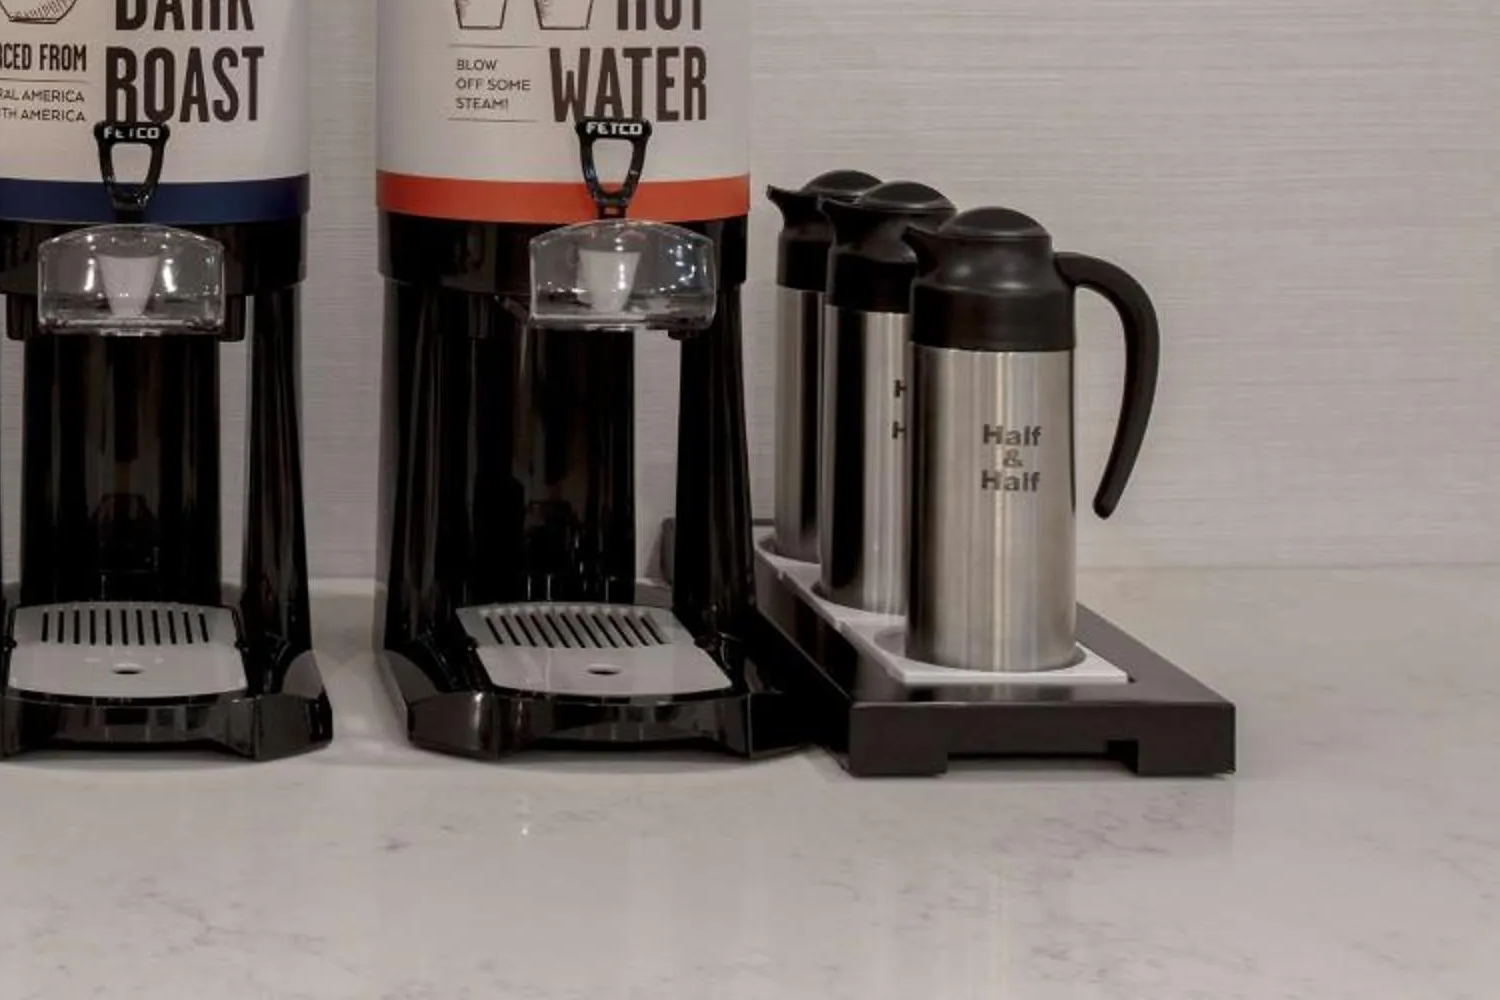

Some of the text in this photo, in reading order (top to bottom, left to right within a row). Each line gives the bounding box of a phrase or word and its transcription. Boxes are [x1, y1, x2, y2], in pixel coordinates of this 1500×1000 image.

[39, 43, 87, 72] FROM
[456, 58, 498, 72] BLOW
[106, 45, 265, 123] ROAST
[455, 78, 532, 92] OFF SOME
[549, 46, 708, 123] WATER
[22, 88, 85, 103] AMERICA
[20, 108, 86, 122] AMERICA
[585, 122, 643, 135] FETCO
[983, 424, 1042, 446] Half
[1003, 448, 1024, 468] &
[981, 469, 1041, 492] Half
